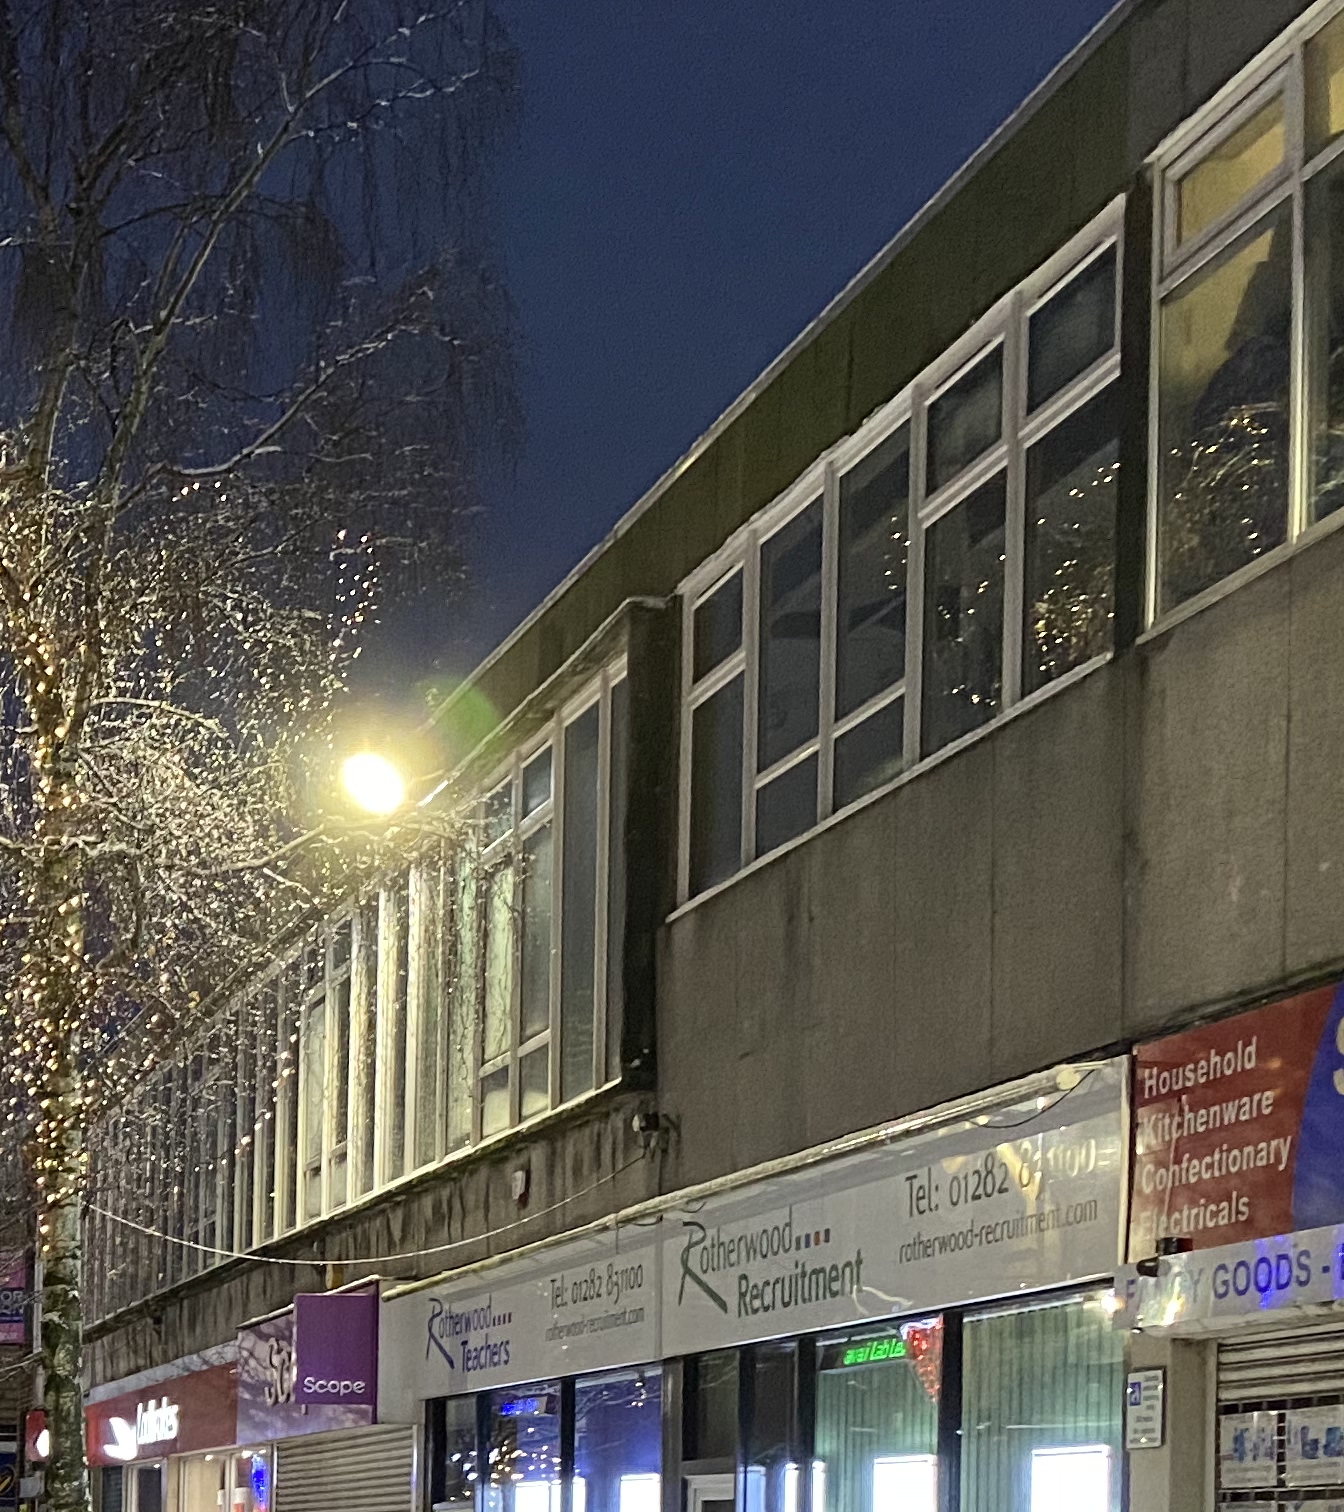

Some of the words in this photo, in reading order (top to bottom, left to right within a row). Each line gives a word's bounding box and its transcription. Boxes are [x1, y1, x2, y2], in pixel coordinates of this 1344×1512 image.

[1143, 1035, 1257, 1099] Household
[1141, 1090, 1274, 1146] Kitchenware
[904, 1166, 940, 1219] Tel:
[948, 1153, 1009, 1208] 01282
[1141, 1135, 1293, 1195] Confectionary
[899, 1198, 1098, 1265] rotherwood-recruitment.com
[1139, 1191, 1250, 1237] Electricals
[549, 1272, 568, 1310] Tel:
[571, 1267, 602, 1306] 01282
[678, 1205, 794, 1313] Rotherwood
[736, 1250, 863, 1318] Recruitment
[1212, 1248, 1312, 1300] GOODS
[426, 1293, 492, 1369] Rotherwood
[460, 1338, 511, 1373] Teachers
[302, 1376, 366, 1396] Scope
